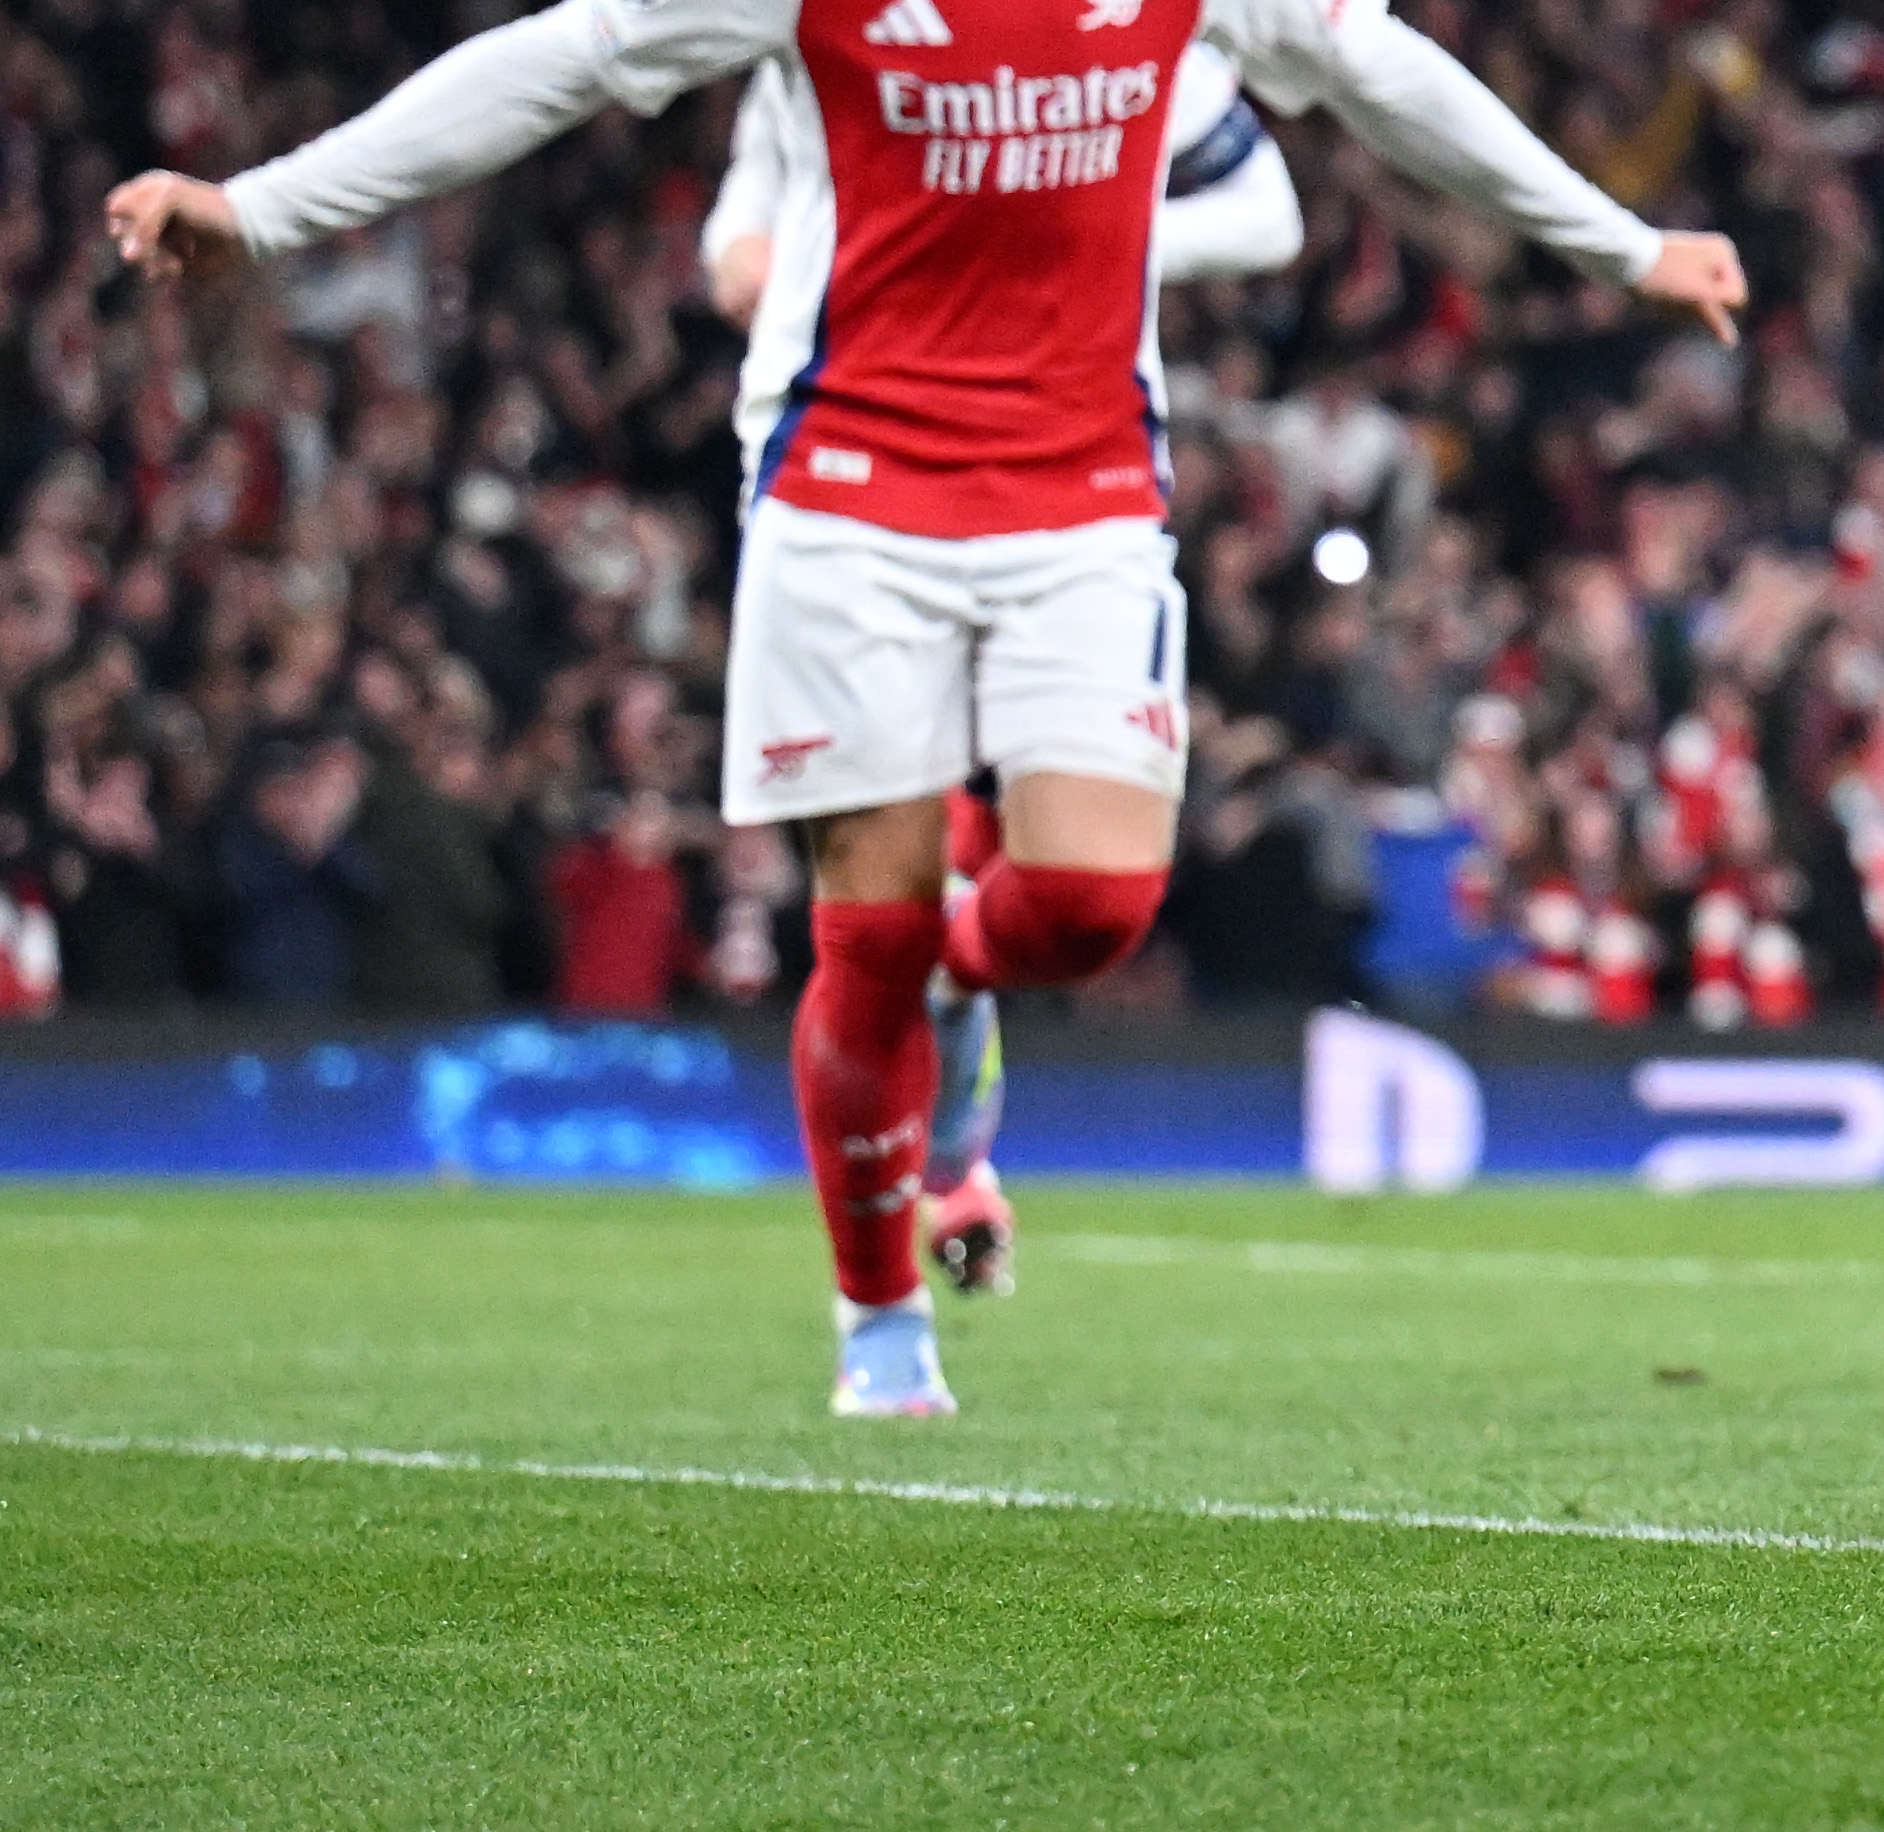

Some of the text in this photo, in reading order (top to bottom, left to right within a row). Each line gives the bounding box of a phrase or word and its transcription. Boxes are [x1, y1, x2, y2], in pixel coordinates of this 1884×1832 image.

[878, 59, 1160, 137] Emirates
[921, 123, 1124, 195] FLY BETTER
